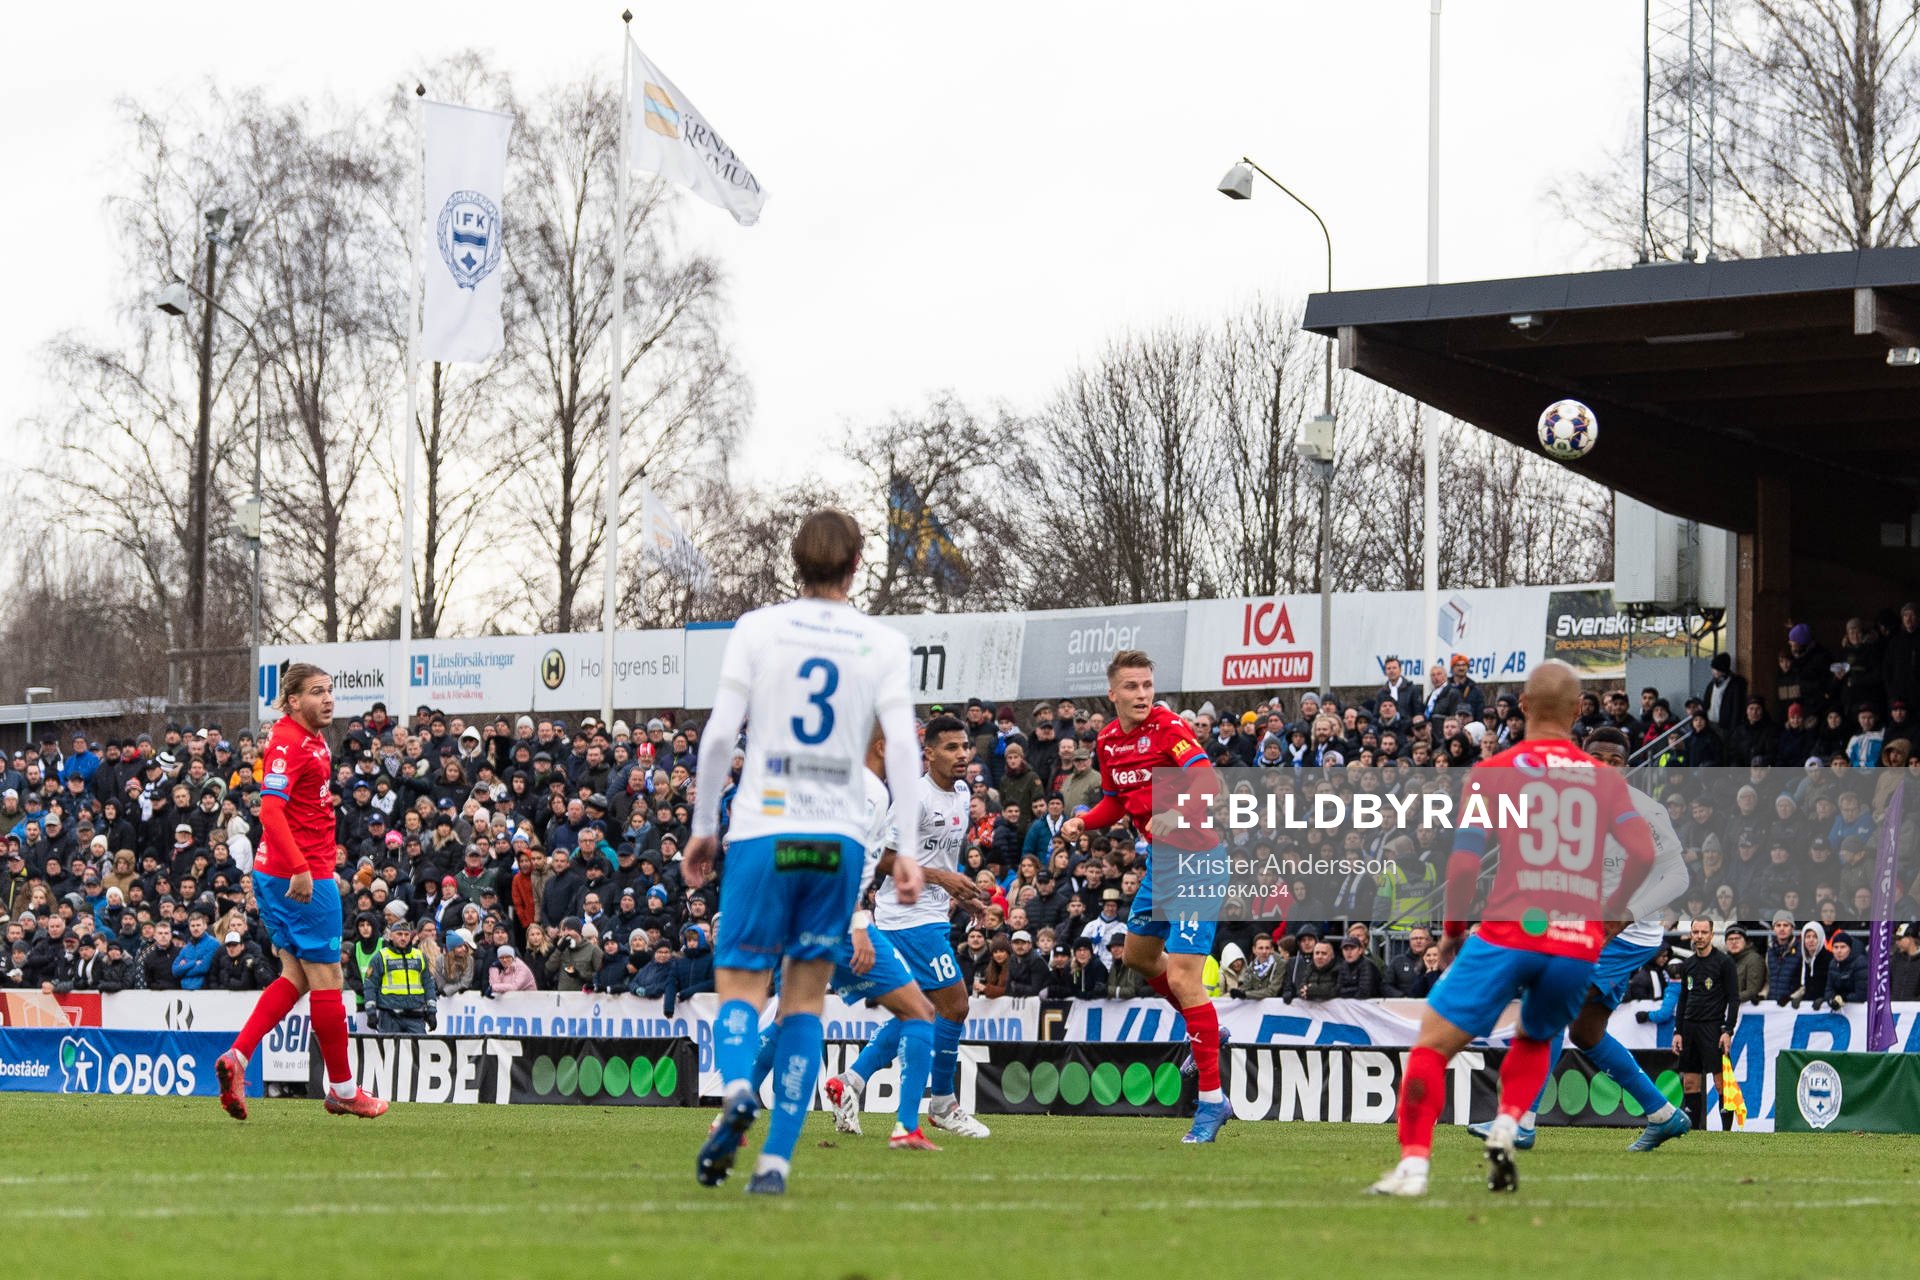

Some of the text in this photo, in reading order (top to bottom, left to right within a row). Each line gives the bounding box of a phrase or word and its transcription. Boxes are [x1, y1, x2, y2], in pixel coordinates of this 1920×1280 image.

[455, 210, 486, 230] IFK
[1243, 601, 1296, 646] ICA
[1068, 620, 1141, 656] amber
[431, 651, 516, 670] Länsförsäkringar
[580, 654, 680, 682] Hogrens Bil
[1225, 656, 1309, 681] KVANTUM
[1501, 650, 1526, 674] AB
[332, 668, 385, 689] riteknik
[431, 670, 481, 688] Jönköping
[790, 657, 840, 746] 3
[1518, 780, 1598, 873] 39
[1179, 910, 1199, 931] 14
[929, 952, 957, 983] 18
[108, 1053, 196, 1096] OBOS
[1230, 1047, 1486, 1126] UNIBT
[1810, 1077, 1829, 1087] IFK
